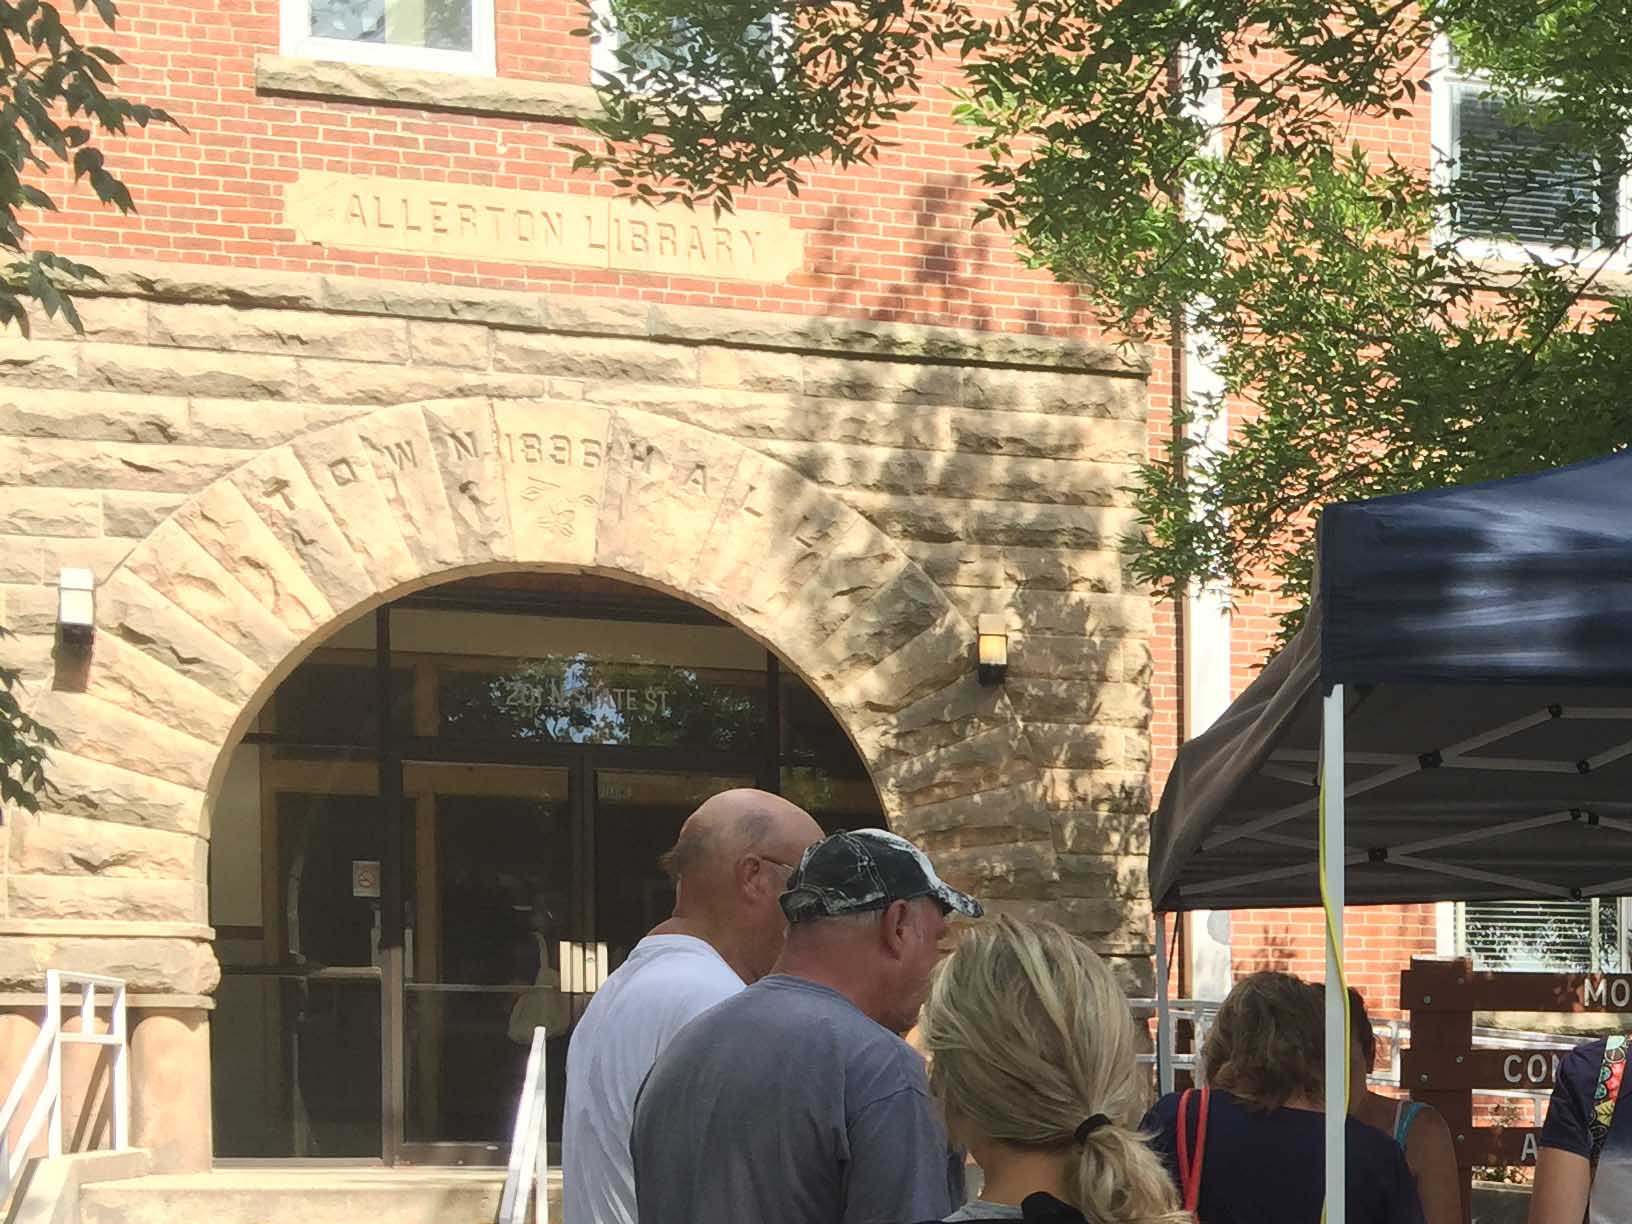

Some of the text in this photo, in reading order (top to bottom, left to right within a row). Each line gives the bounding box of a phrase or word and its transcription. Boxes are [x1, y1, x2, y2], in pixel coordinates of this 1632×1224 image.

[346, 193, 762, 265] ALLERTON LIBRARY
[262, 431, 479, 510] TOWN
